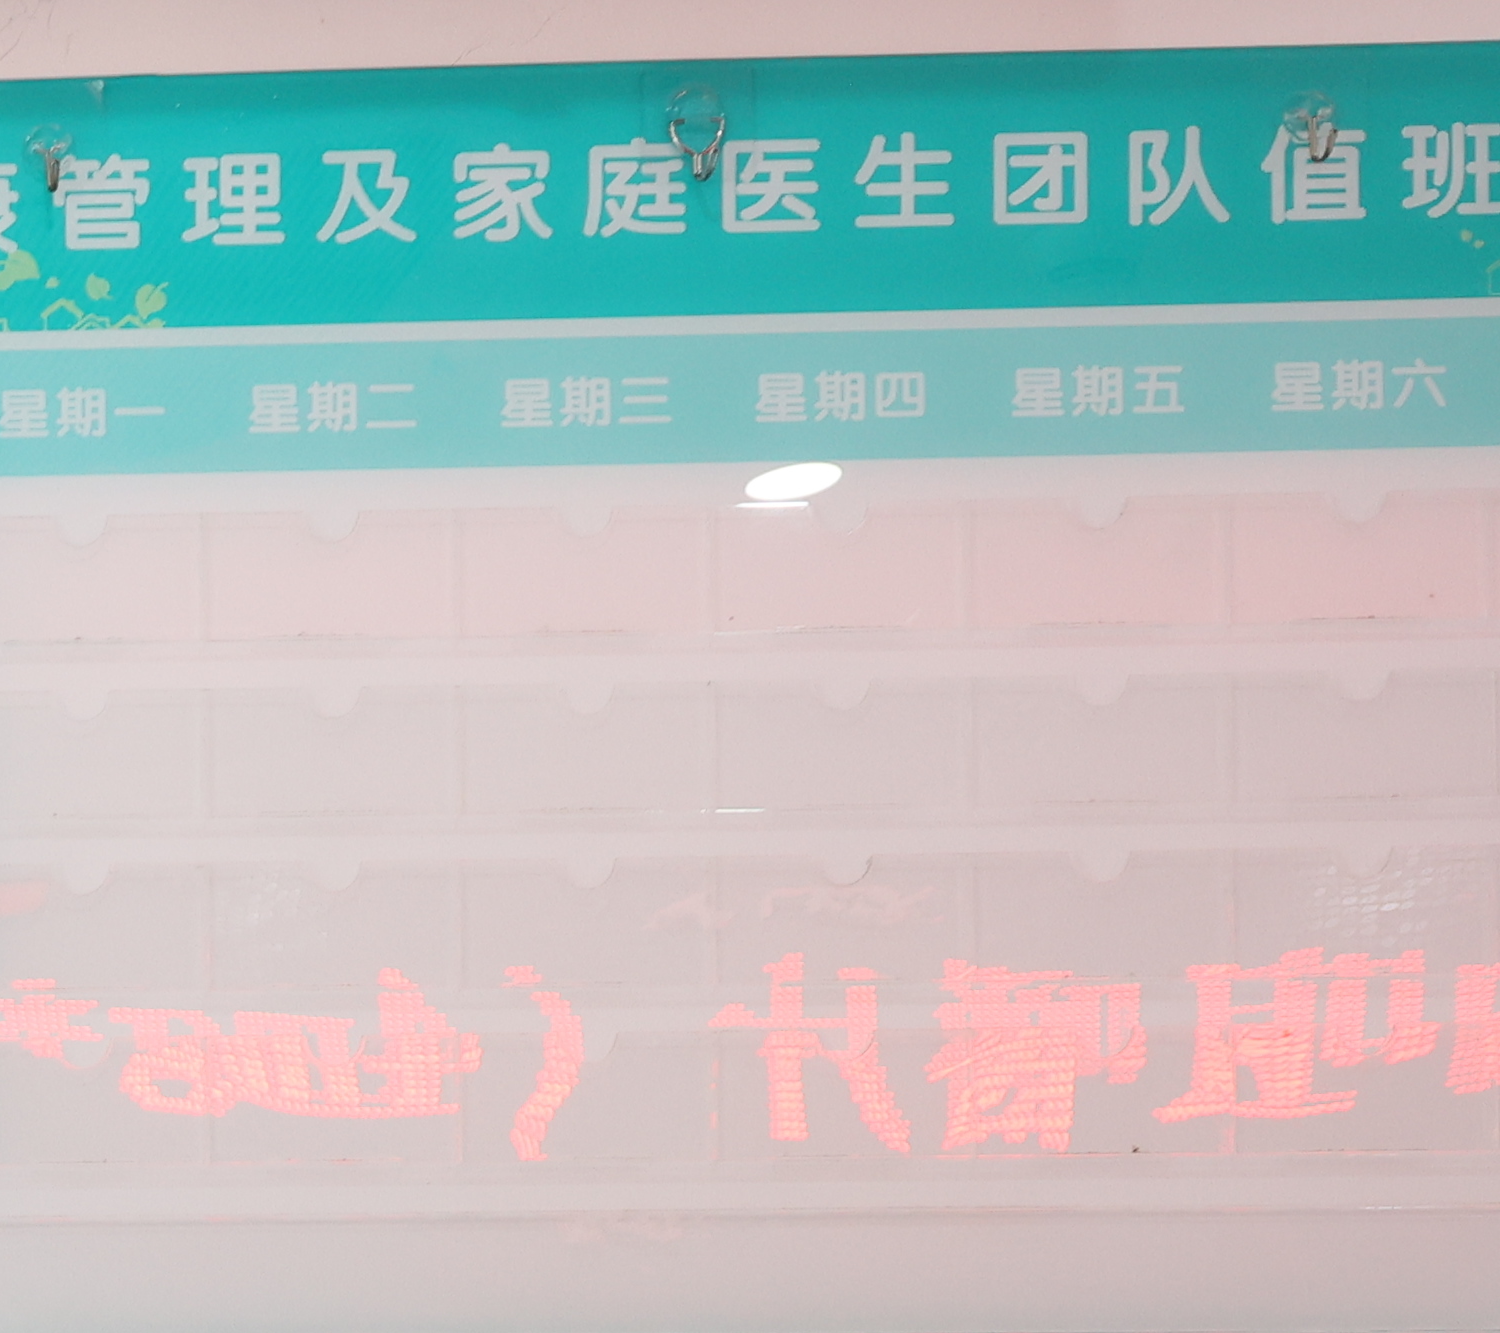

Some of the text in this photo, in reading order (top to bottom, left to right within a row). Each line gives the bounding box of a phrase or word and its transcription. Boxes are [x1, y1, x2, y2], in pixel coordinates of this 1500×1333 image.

[249, 381, 418, 435] 星期二
[501, 374, 673, 431] 星期三
[755, 369, 927, 424] 星期四
[1011, 364, 1185, 420] 星期五
[1270, 358, 1448, 413] 星期六
